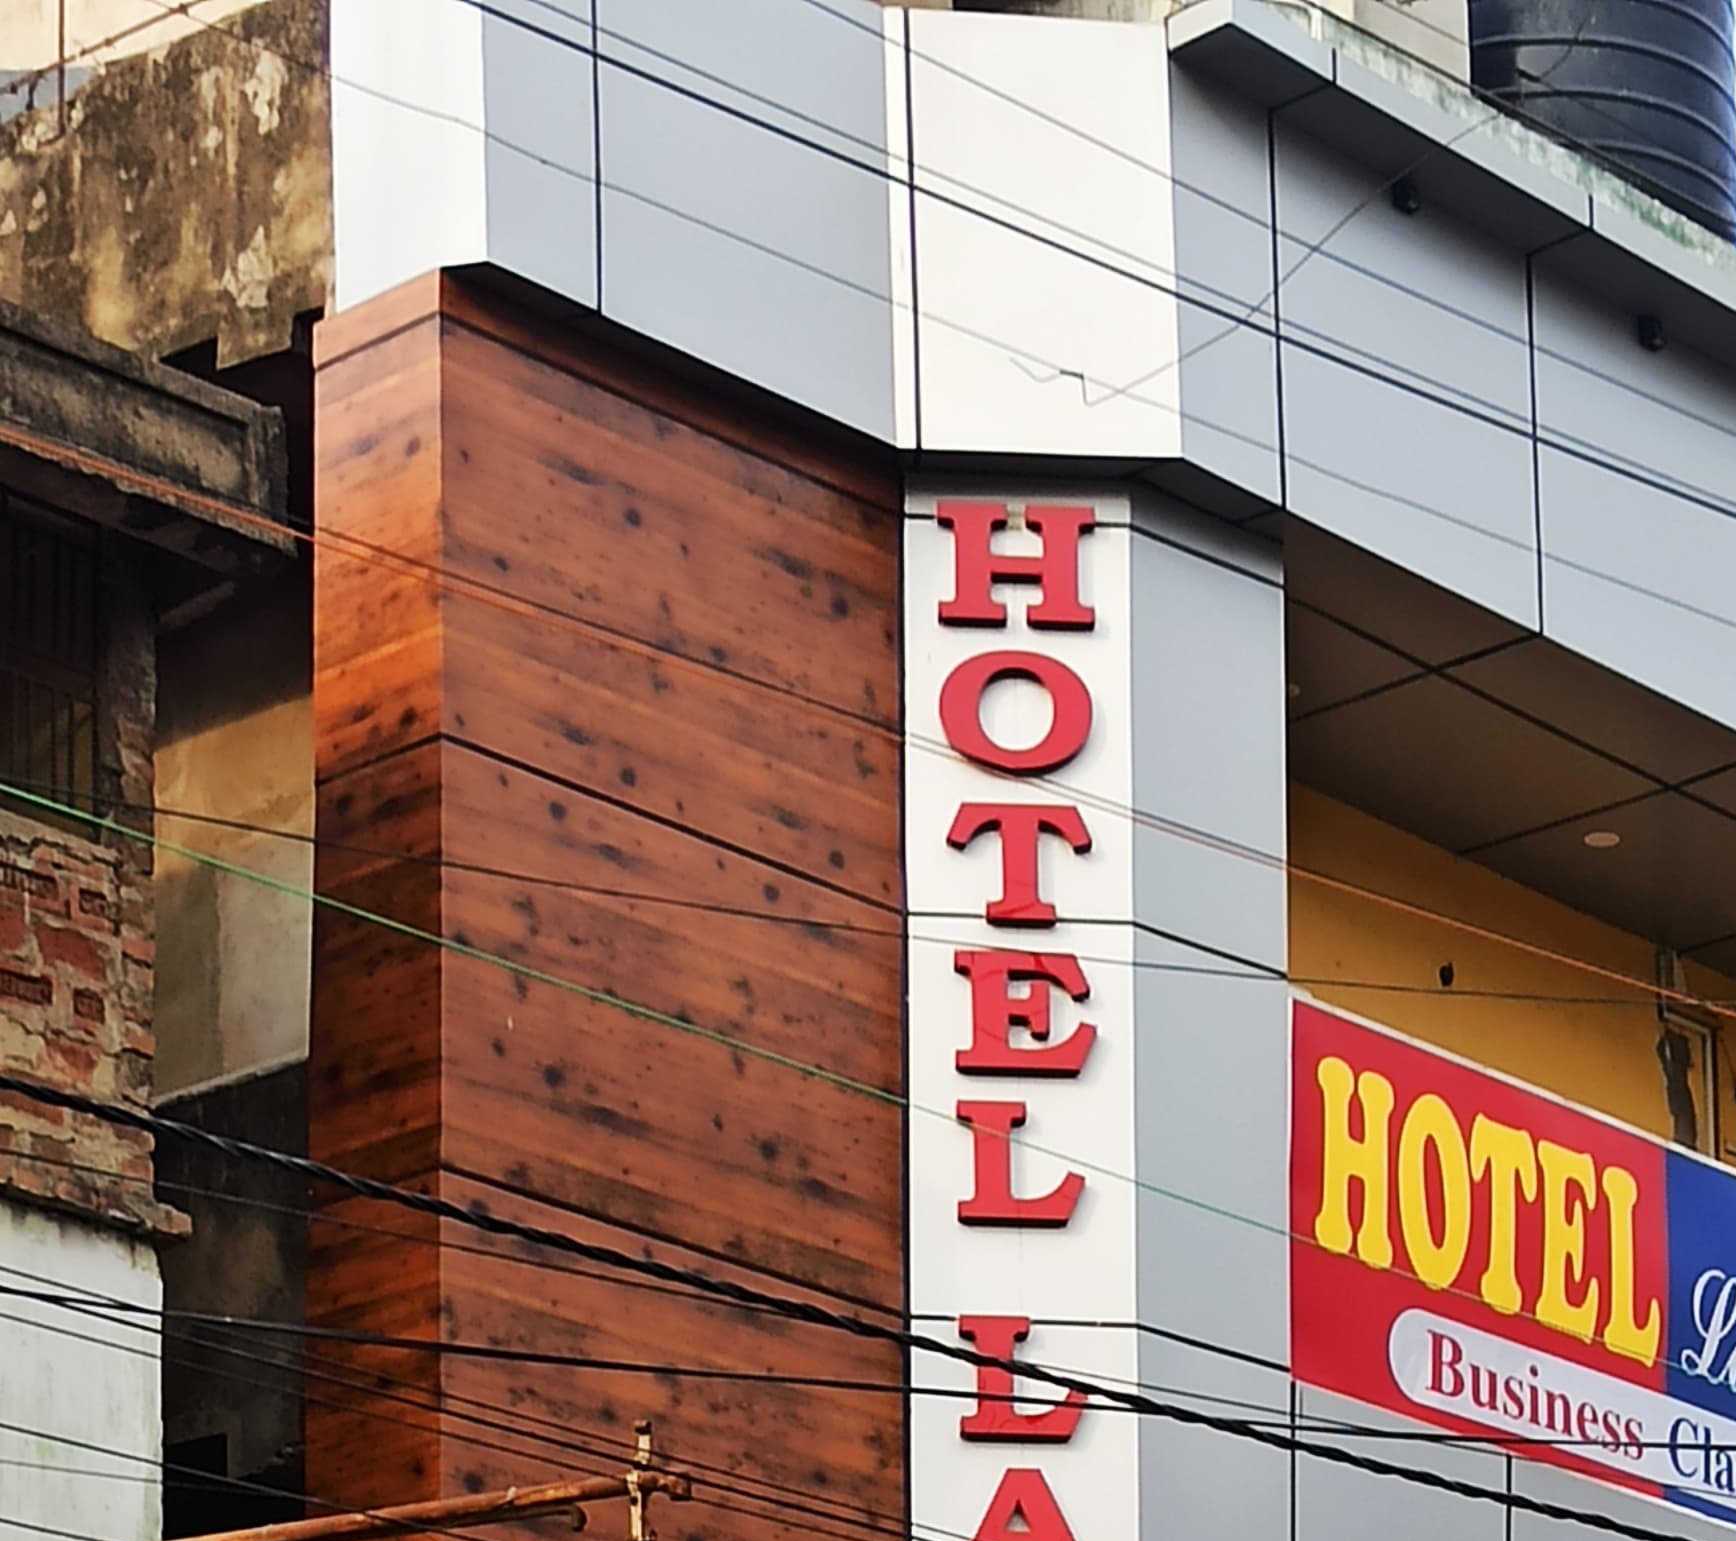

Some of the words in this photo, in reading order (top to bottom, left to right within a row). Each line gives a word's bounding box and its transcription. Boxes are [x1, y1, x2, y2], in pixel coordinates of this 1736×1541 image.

[936, 500, 1097, 1229] HOTEL
[1313, 1055, 1661, 1367] HOTEL
[1424, 1328, 1645, 1461] Business
